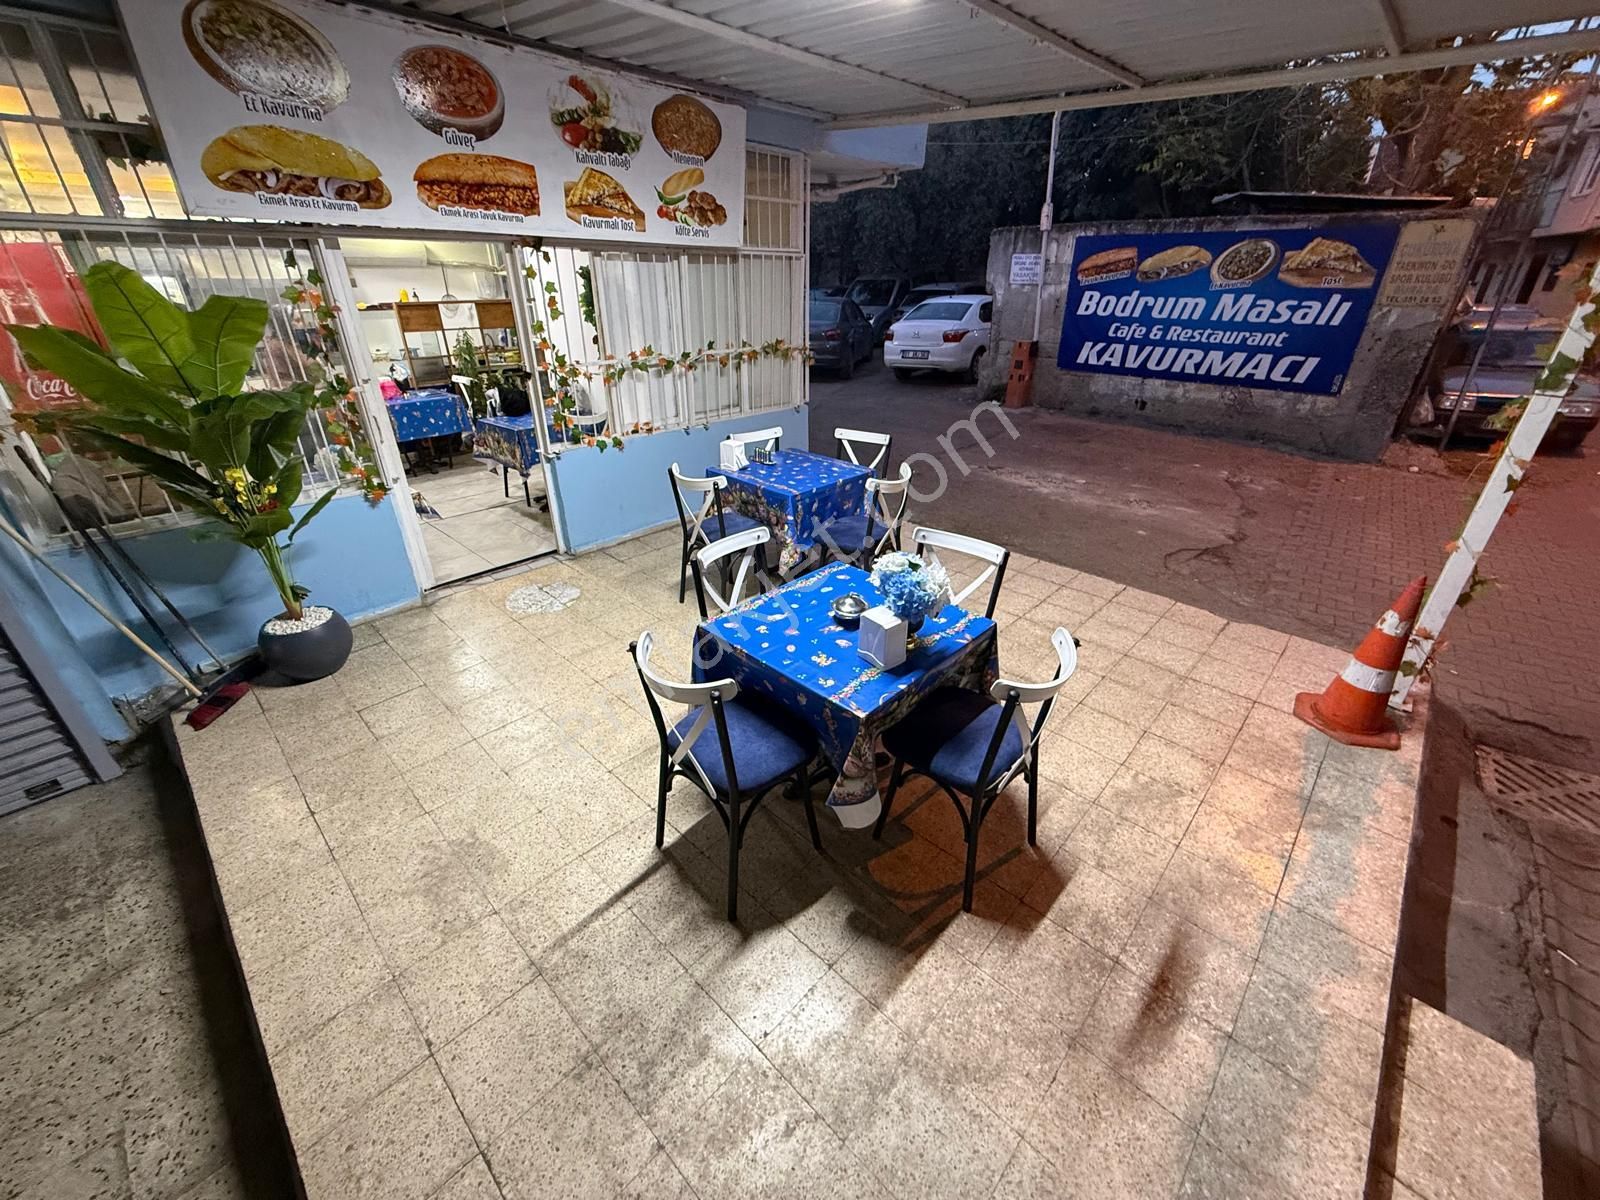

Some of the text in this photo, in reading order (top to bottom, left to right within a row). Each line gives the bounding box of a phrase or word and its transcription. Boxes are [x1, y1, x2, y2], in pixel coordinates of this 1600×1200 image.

[243, 94, 323, 121] Et Kavurma
[444, 130, 475, 151] Güveç
[575, 151, 631, 170] Kahvaltı Tabağı
[673, 152, 703, 167] Menemen
[258, 193, 358, 212] Ekmek Arası Et Kavurma
[440, 207, 524, 223] Ekmek Arası Tavuk Kavurma
[583, 217, 634, 231] Kavurmalı Tost
[675, 225, 709, 238] Köfte Servis
[1322, 276, 1343, 286] Tost
[1076, 290, 1352, 326] Bodrum Masalı
[1108, 323, 1289, 347] Cafe & Restaurant
[1076, 341, 1320, 384] KAVURMACI
